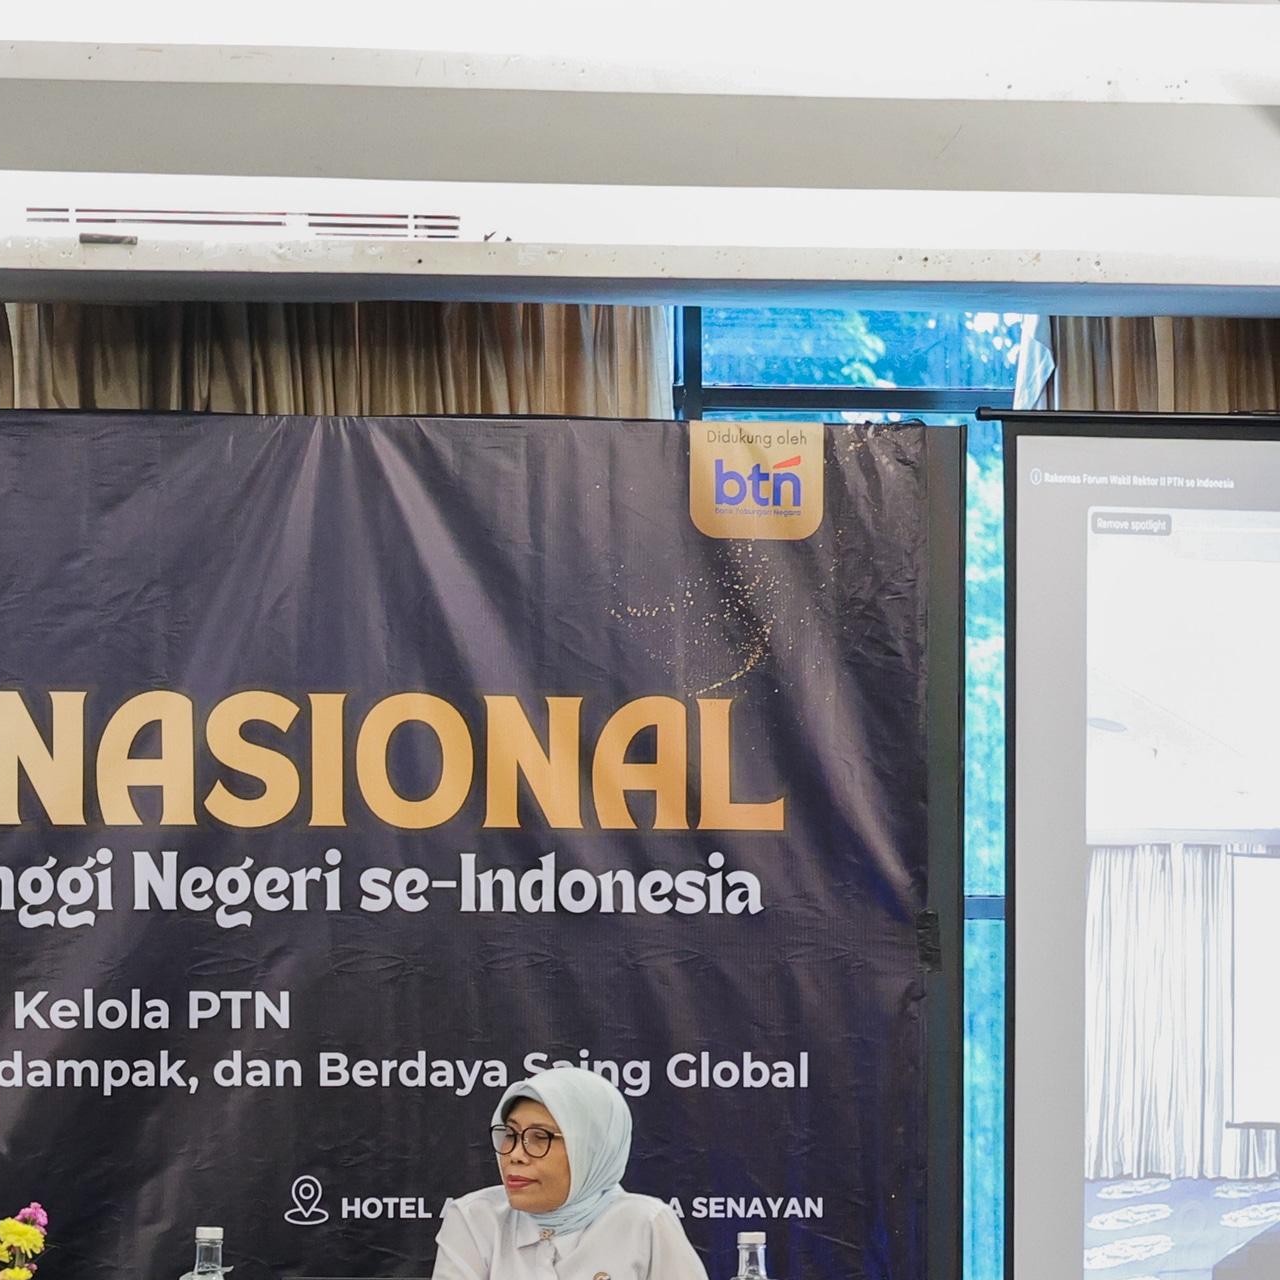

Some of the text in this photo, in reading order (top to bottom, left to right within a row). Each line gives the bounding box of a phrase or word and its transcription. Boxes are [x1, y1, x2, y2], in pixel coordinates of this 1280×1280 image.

[707, 429, 807, 447] Didukung oleh
[715, 457, 801, 506] btn
[1044, 472, 1081, 484] Rakornas
[1083, 473, 1108, 485] Forum
[1109, 475, 1131, 486] Wakil
[1133, 475, 1158, 486] Rektor
[1167, 477, 1184, 487] PTN
[1197, 478, 1235, 489] Indonesia
[1097, 517, 1166, 532] Remove spotlight
[132, 849, 342, 928] Negeri
[359, 849, 765, 915] se-Indonesia
[15, 988, 170, 1031] Kelola
[189, 991, 291, 1029] PTN
[213, 1051, 302, 1089] dan
[319, 1050, 508, 1096] Berdaya
[666, 1050, 809, 1090] Global
[342, 1197, 432, 1219] HOTEL
[692, 1197, 824, 1219] SENAYAN
